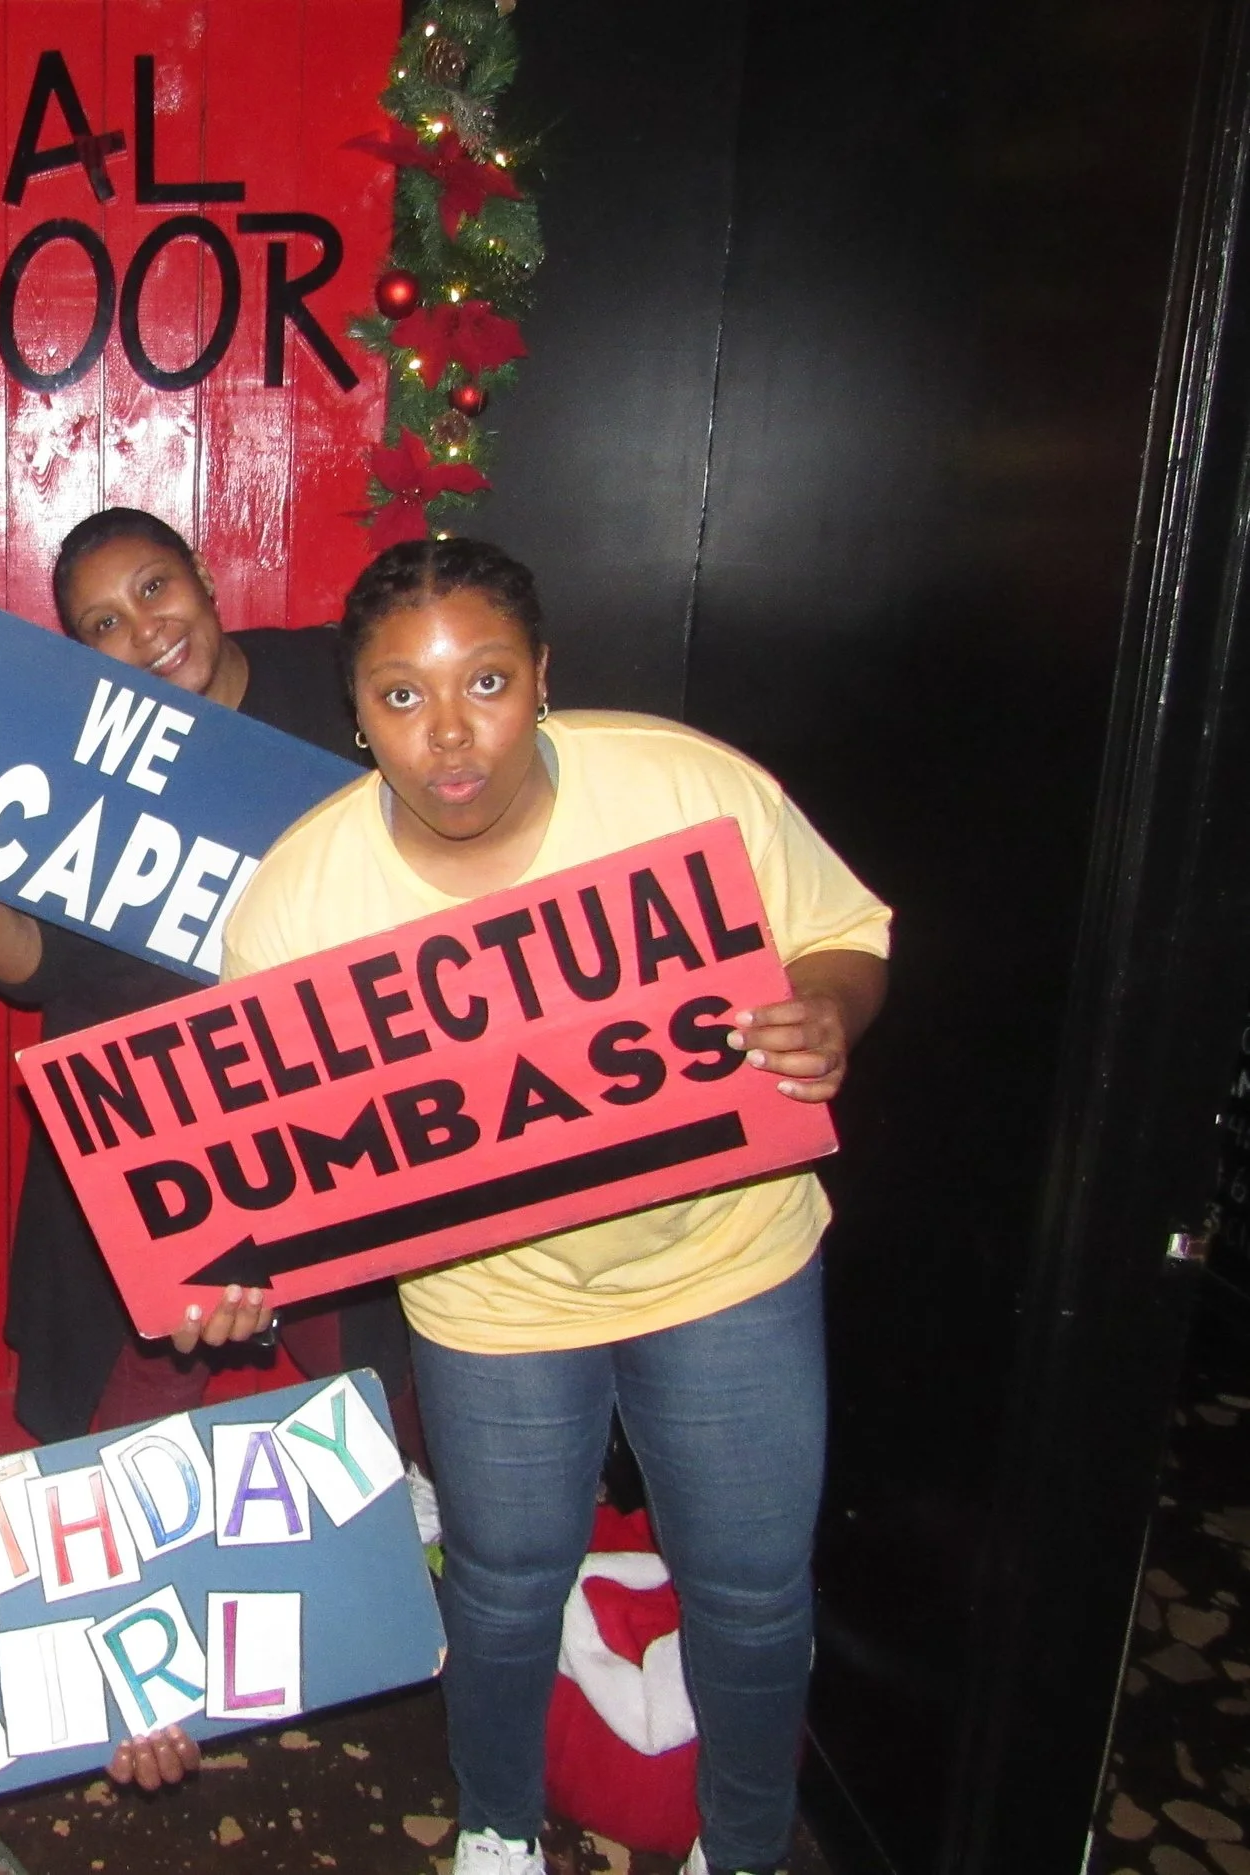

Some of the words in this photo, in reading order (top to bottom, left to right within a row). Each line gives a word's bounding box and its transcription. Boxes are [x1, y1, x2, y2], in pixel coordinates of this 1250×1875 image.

[74, 678, 195, 796] WE
[42, 850, 765, 1157] INTELLECTUAL
[122, 995, 748, 1241] DUMBASS
